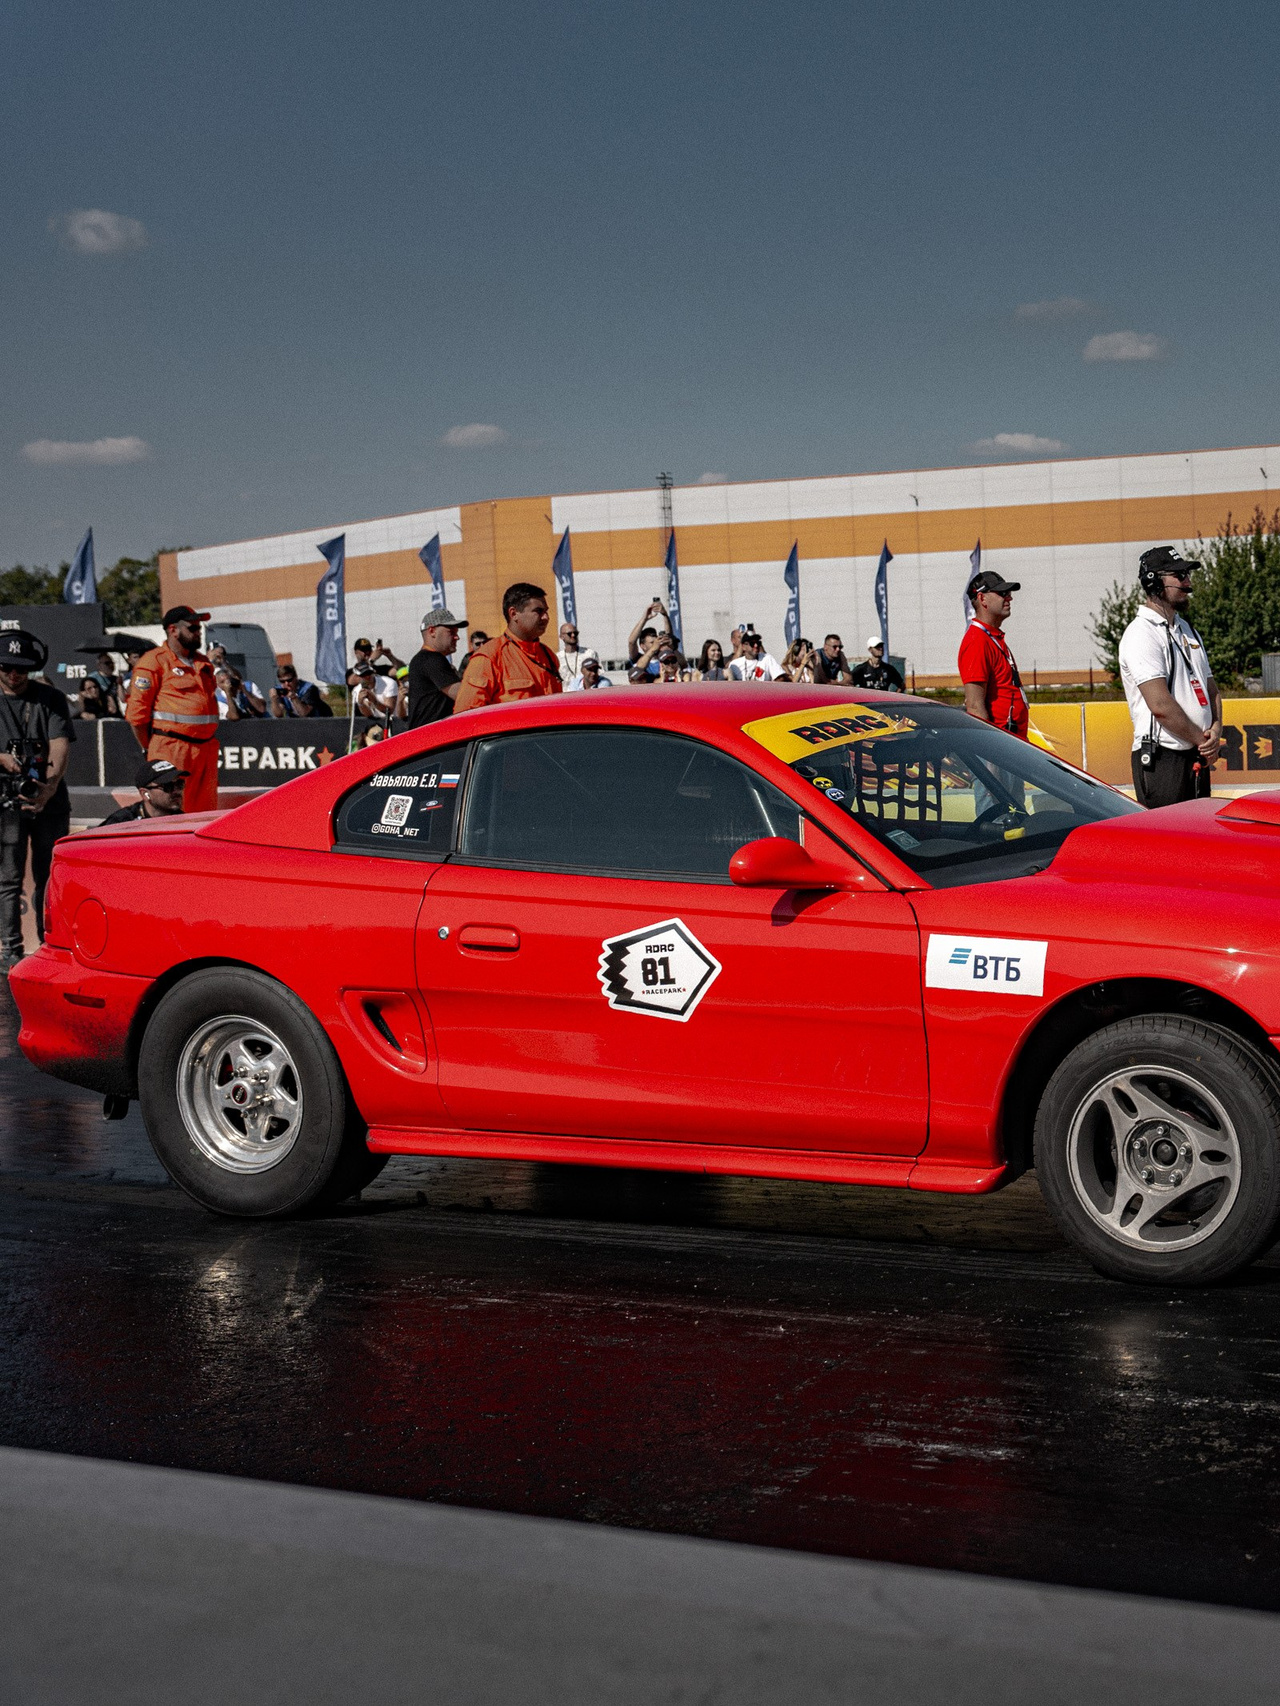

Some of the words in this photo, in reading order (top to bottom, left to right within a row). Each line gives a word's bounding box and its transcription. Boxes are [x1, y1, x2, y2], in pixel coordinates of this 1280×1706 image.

[66, 664, 88, 679] ВТБ
[788, 714, 890, 745] RDRC
[369, 773, 418, 788] Завьялов
[645, 943, 675, 954] RDRC
[640, 956, 676, 987] 81
[973, 953, 1021, 982] ВТБ
[645, 987, 683, 995] RACEPARK
